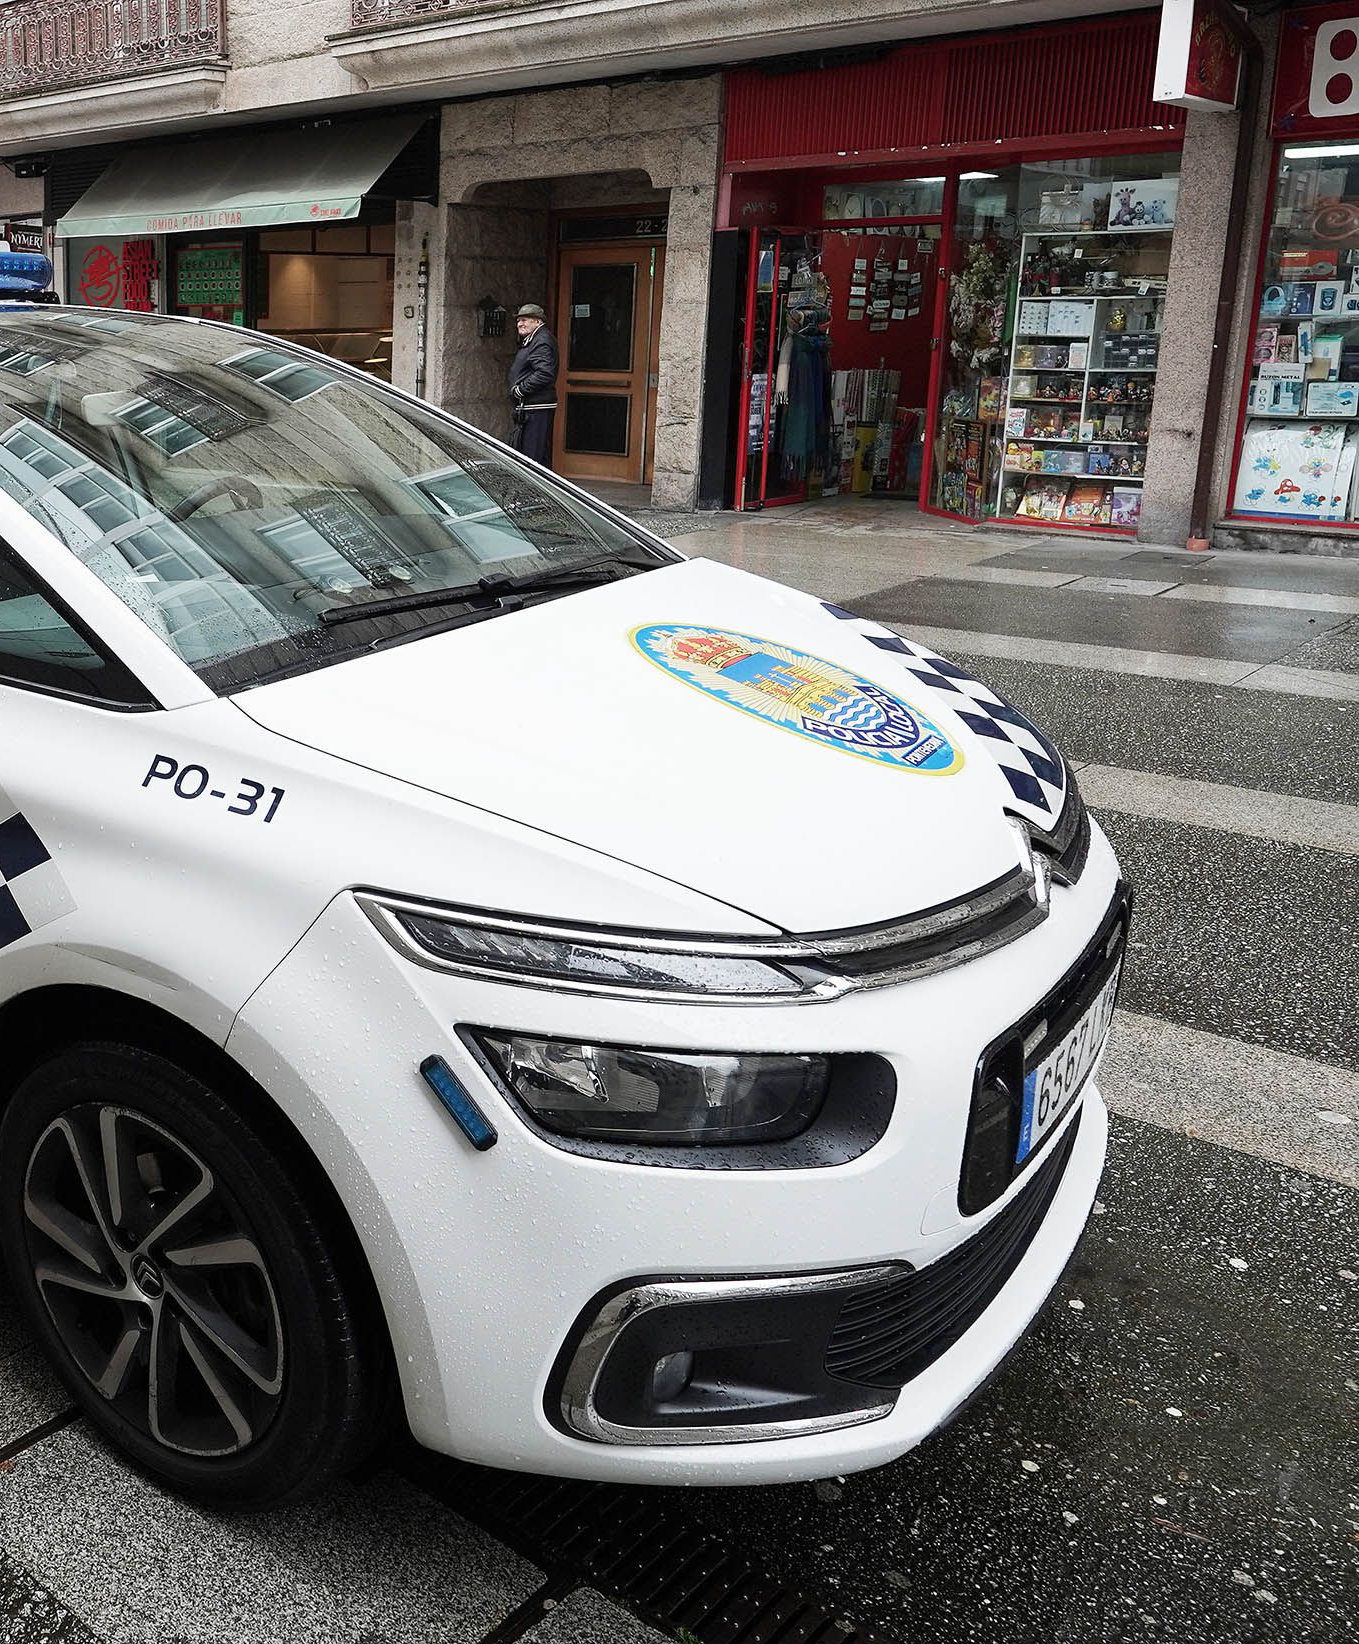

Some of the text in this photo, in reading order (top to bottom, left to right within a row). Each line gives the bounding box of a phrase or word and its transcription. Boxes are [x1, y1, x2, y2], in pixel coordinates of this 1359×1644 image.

[146, 211, 242, 232] COMIDA PARA LLEVAR
[122, 260, 159, 279] STREET
[122, 280, 150, 300] FOOD
[804, 687, 915, 747] POLICIA LOCAL
[905, 735, 945, 765] PONTEVEDRA
[141, 753, 286, 824] PO-31
[1037, 1018, 1090, 1127] 6567
